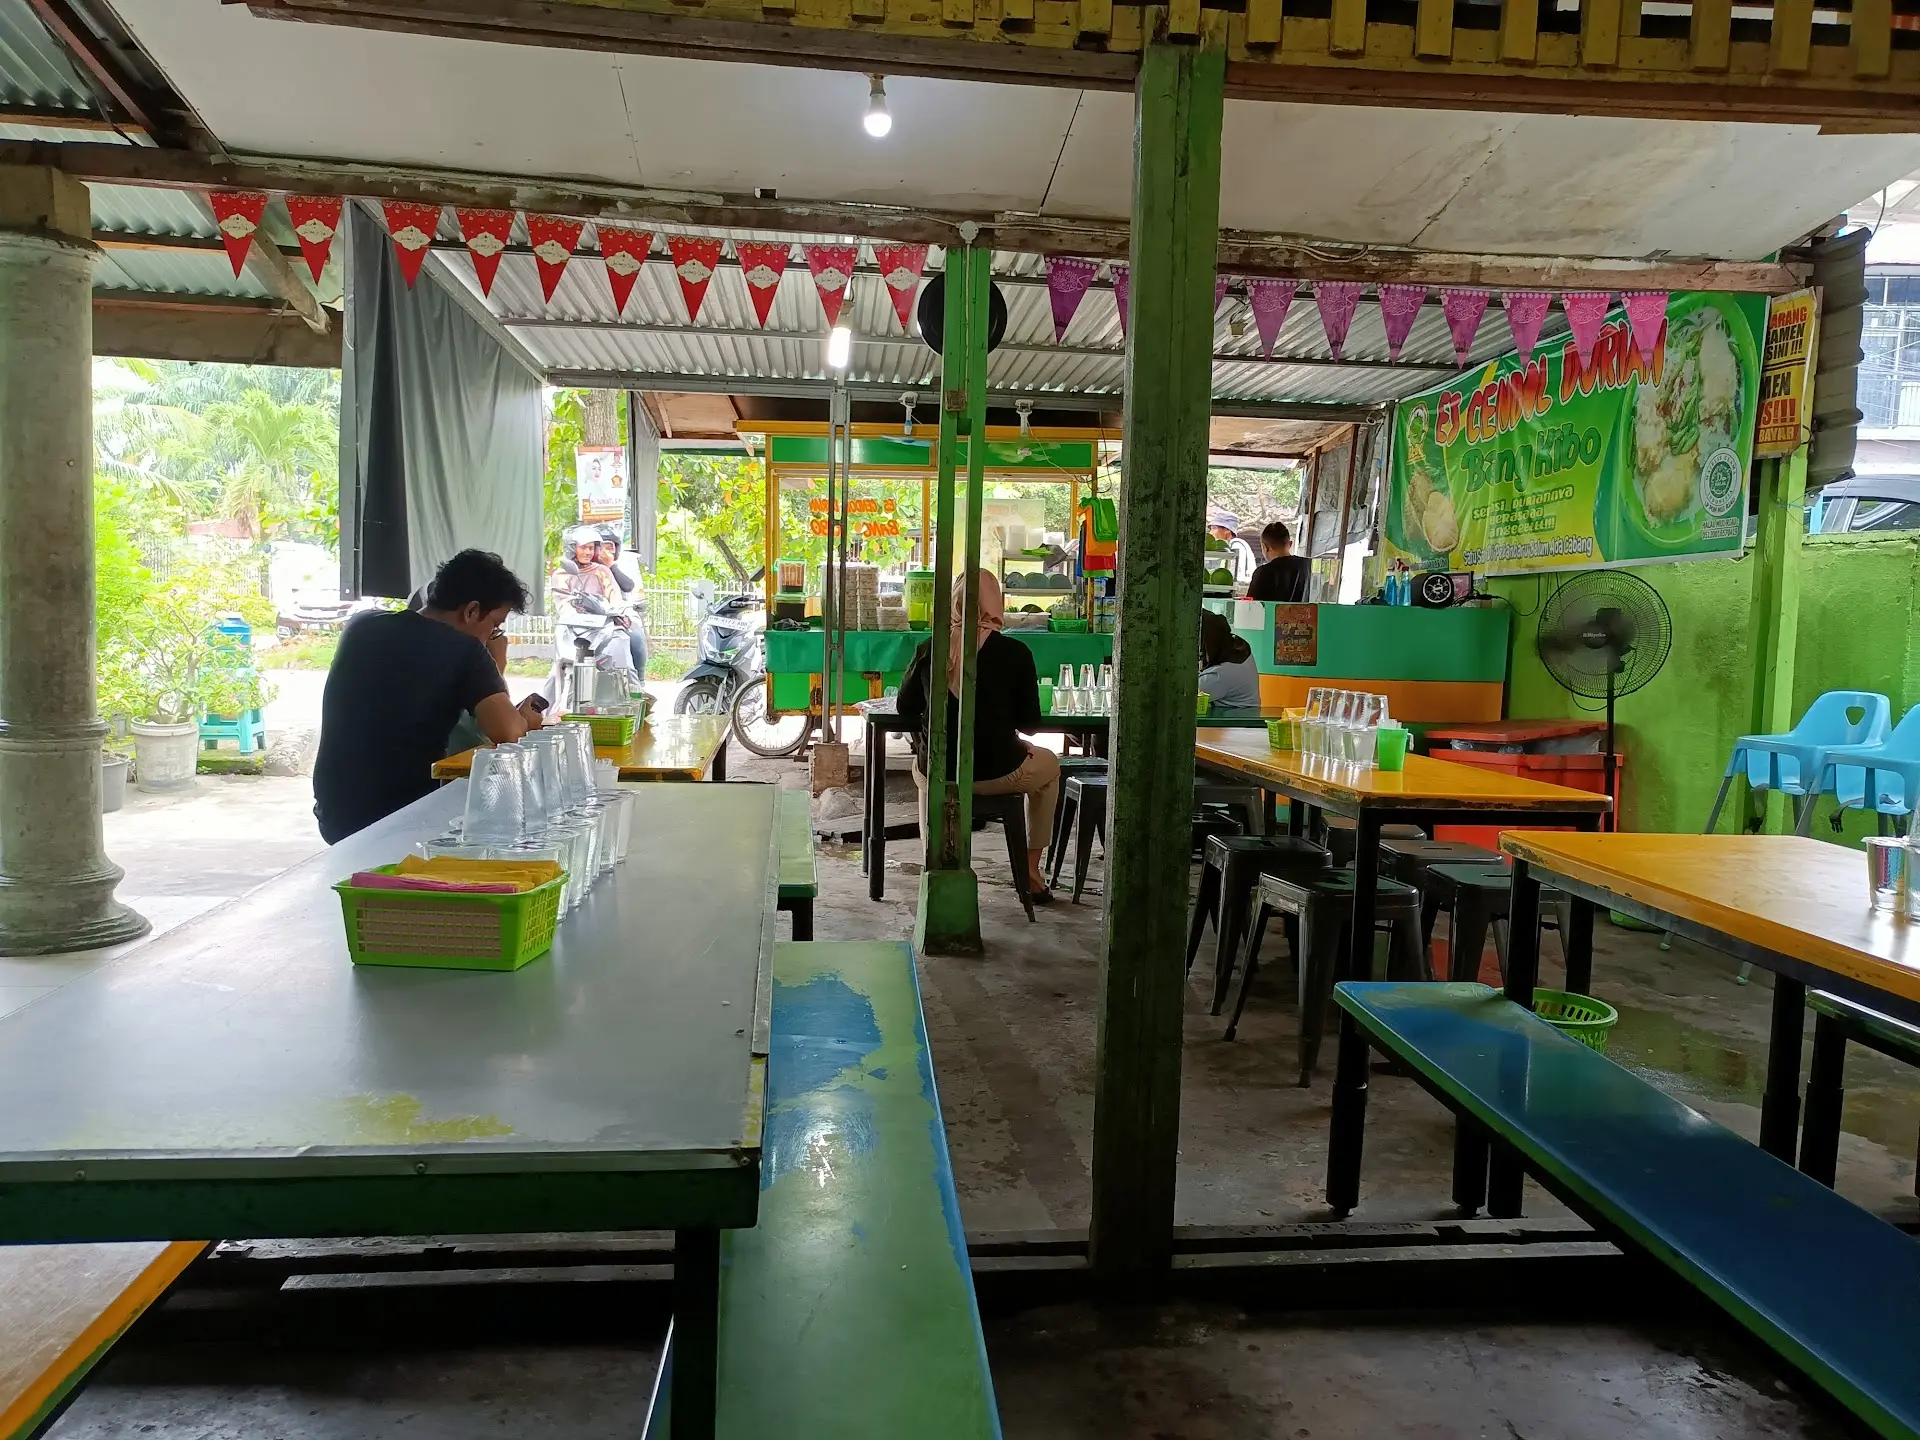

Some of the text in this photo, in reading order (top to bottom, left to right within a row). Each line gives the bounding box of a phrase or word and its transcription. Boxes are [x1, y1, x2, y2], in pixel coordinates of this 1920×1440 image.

[1436, 390, 1462, 447] ES
[1466, 354, 1552, 445] CENDOL
[1461, 423, 1601, 492] Bang Kibo
[1759, 426, 1794, 443] BAYAR
[1563, 534, 1593, 557] Cabang
